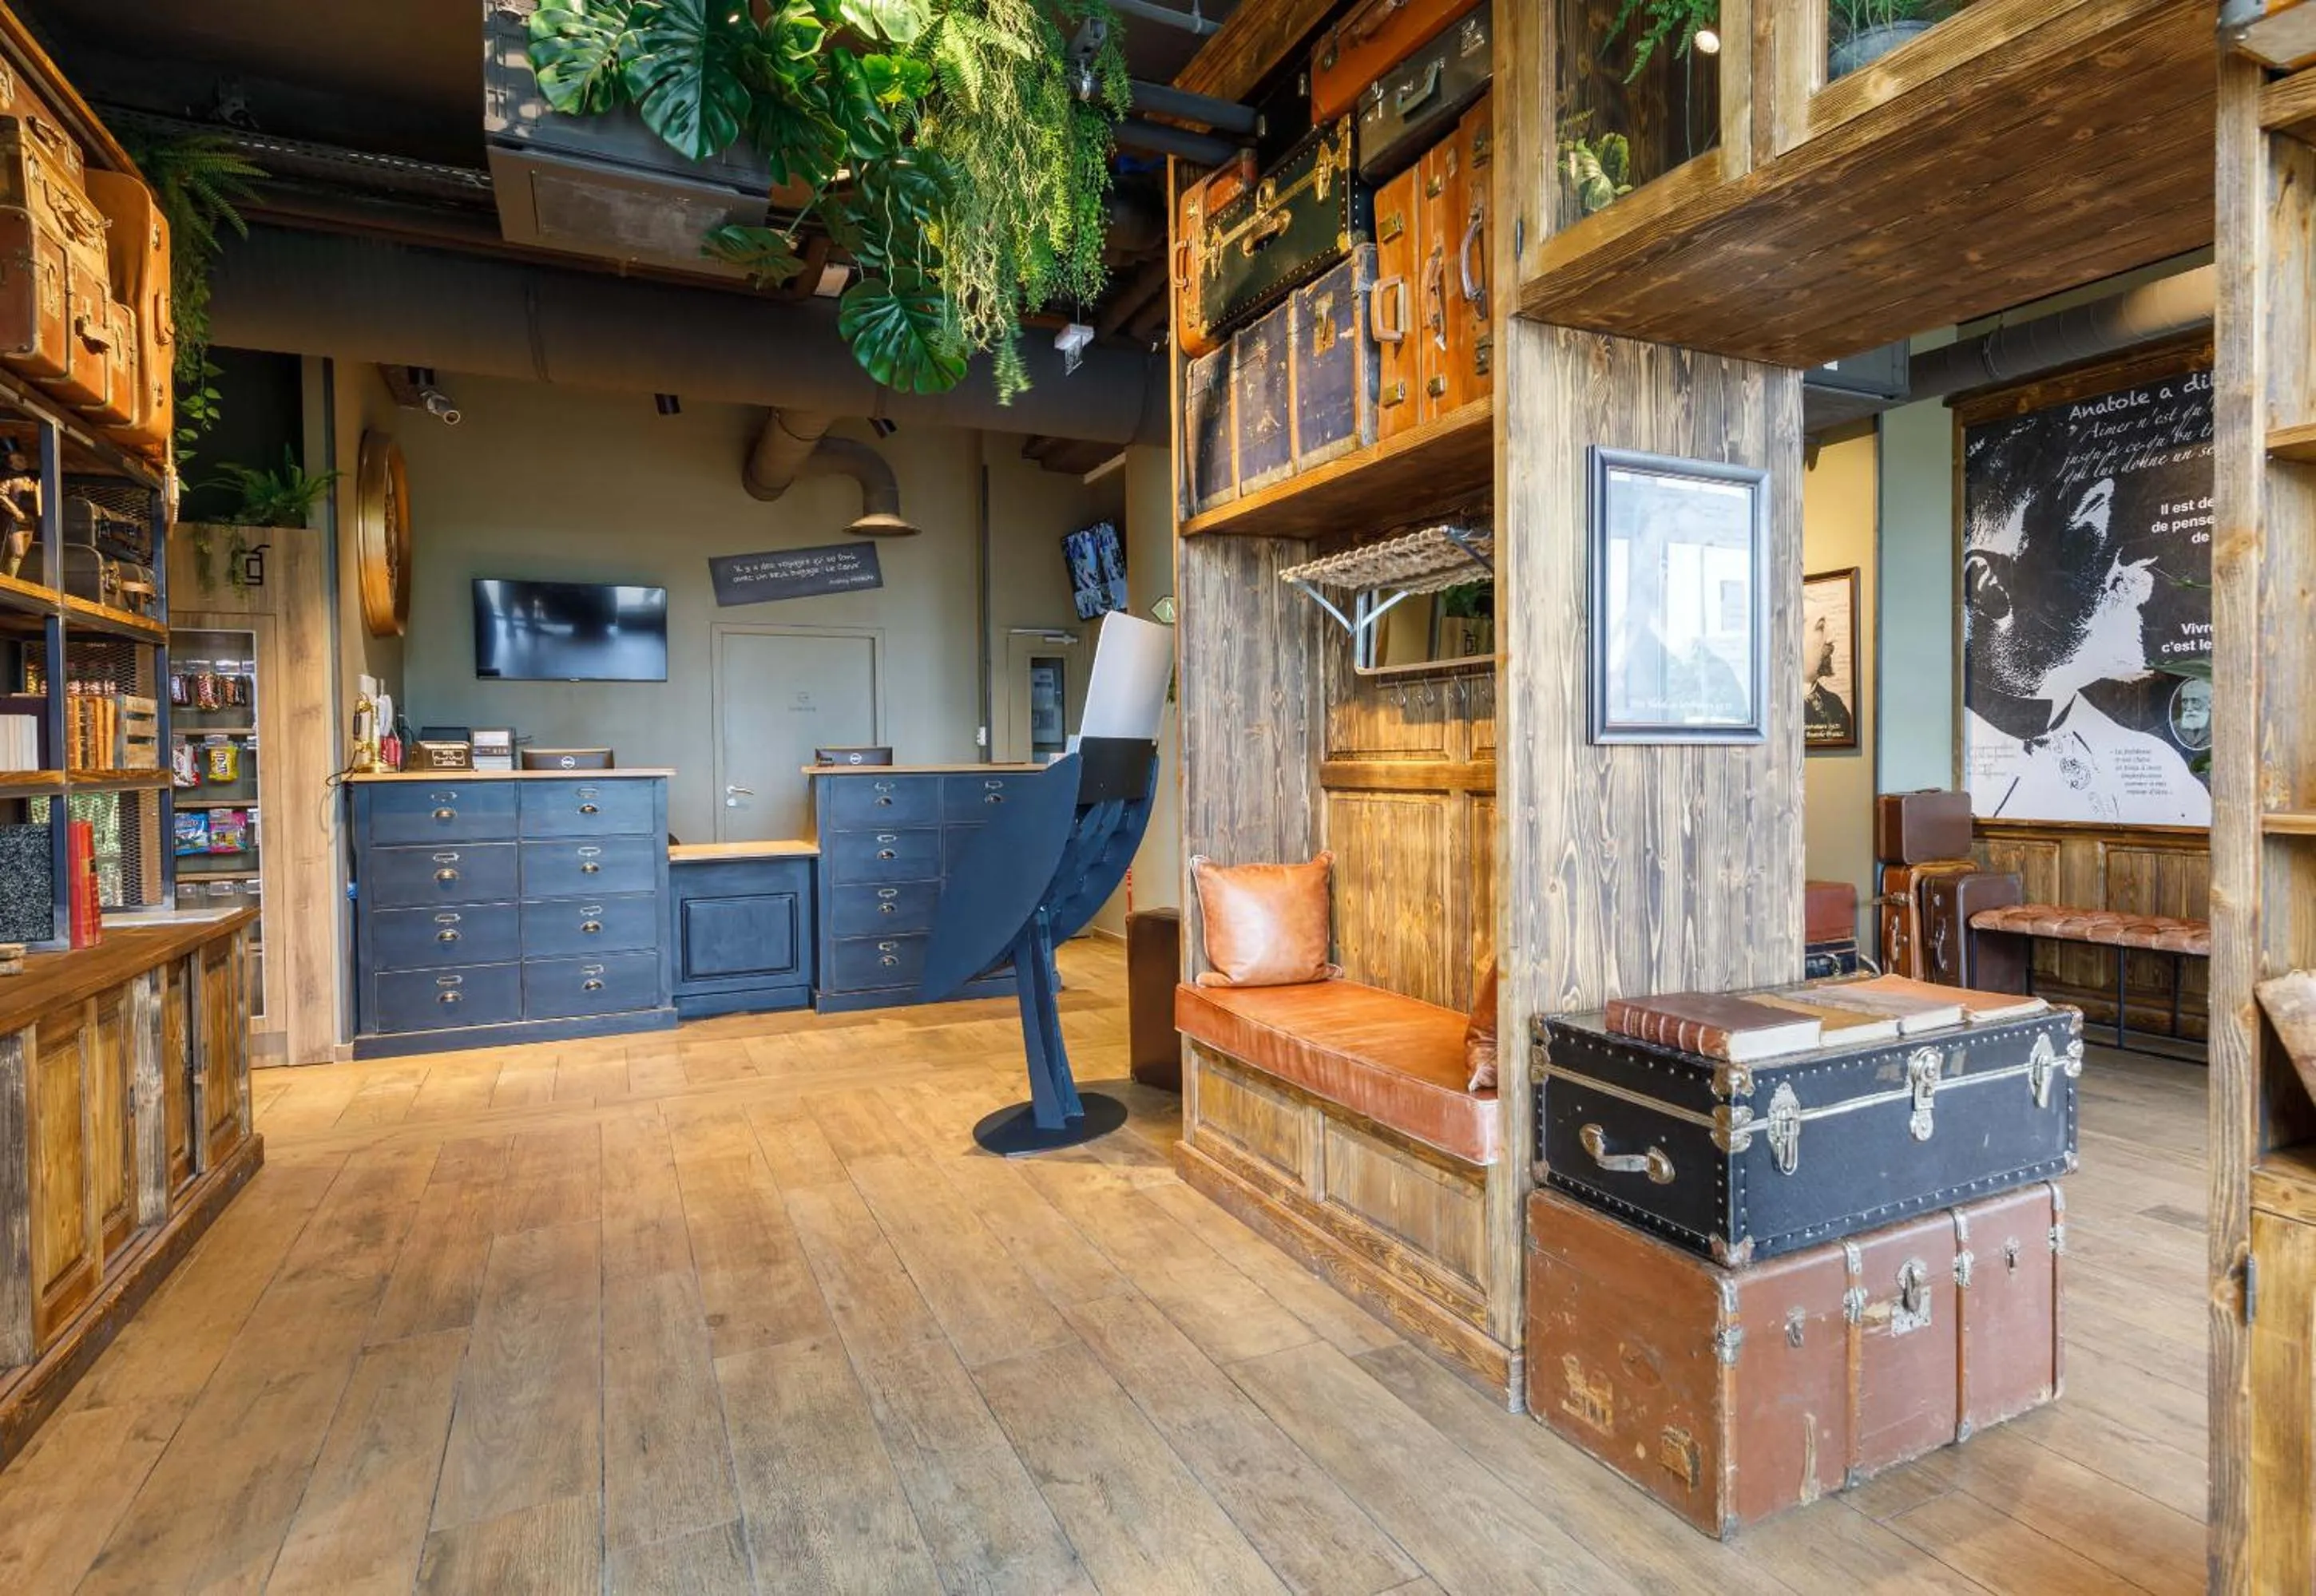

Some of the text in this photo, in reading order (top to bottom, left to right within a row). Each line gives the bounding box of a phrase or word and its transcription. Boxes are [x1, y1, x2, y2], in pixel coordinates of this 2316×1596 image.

[2068, 390, 2151, 422] Anatole
[2159, 386, 2173, 400] a
[2161, 504, 2168, 516] Il
[2171, 500, 2195, 513] est
[2151, 521, 2168, 533] de
[2191, 532, 2210, 544] de
[2161, 640, 2196, 653] c'est
